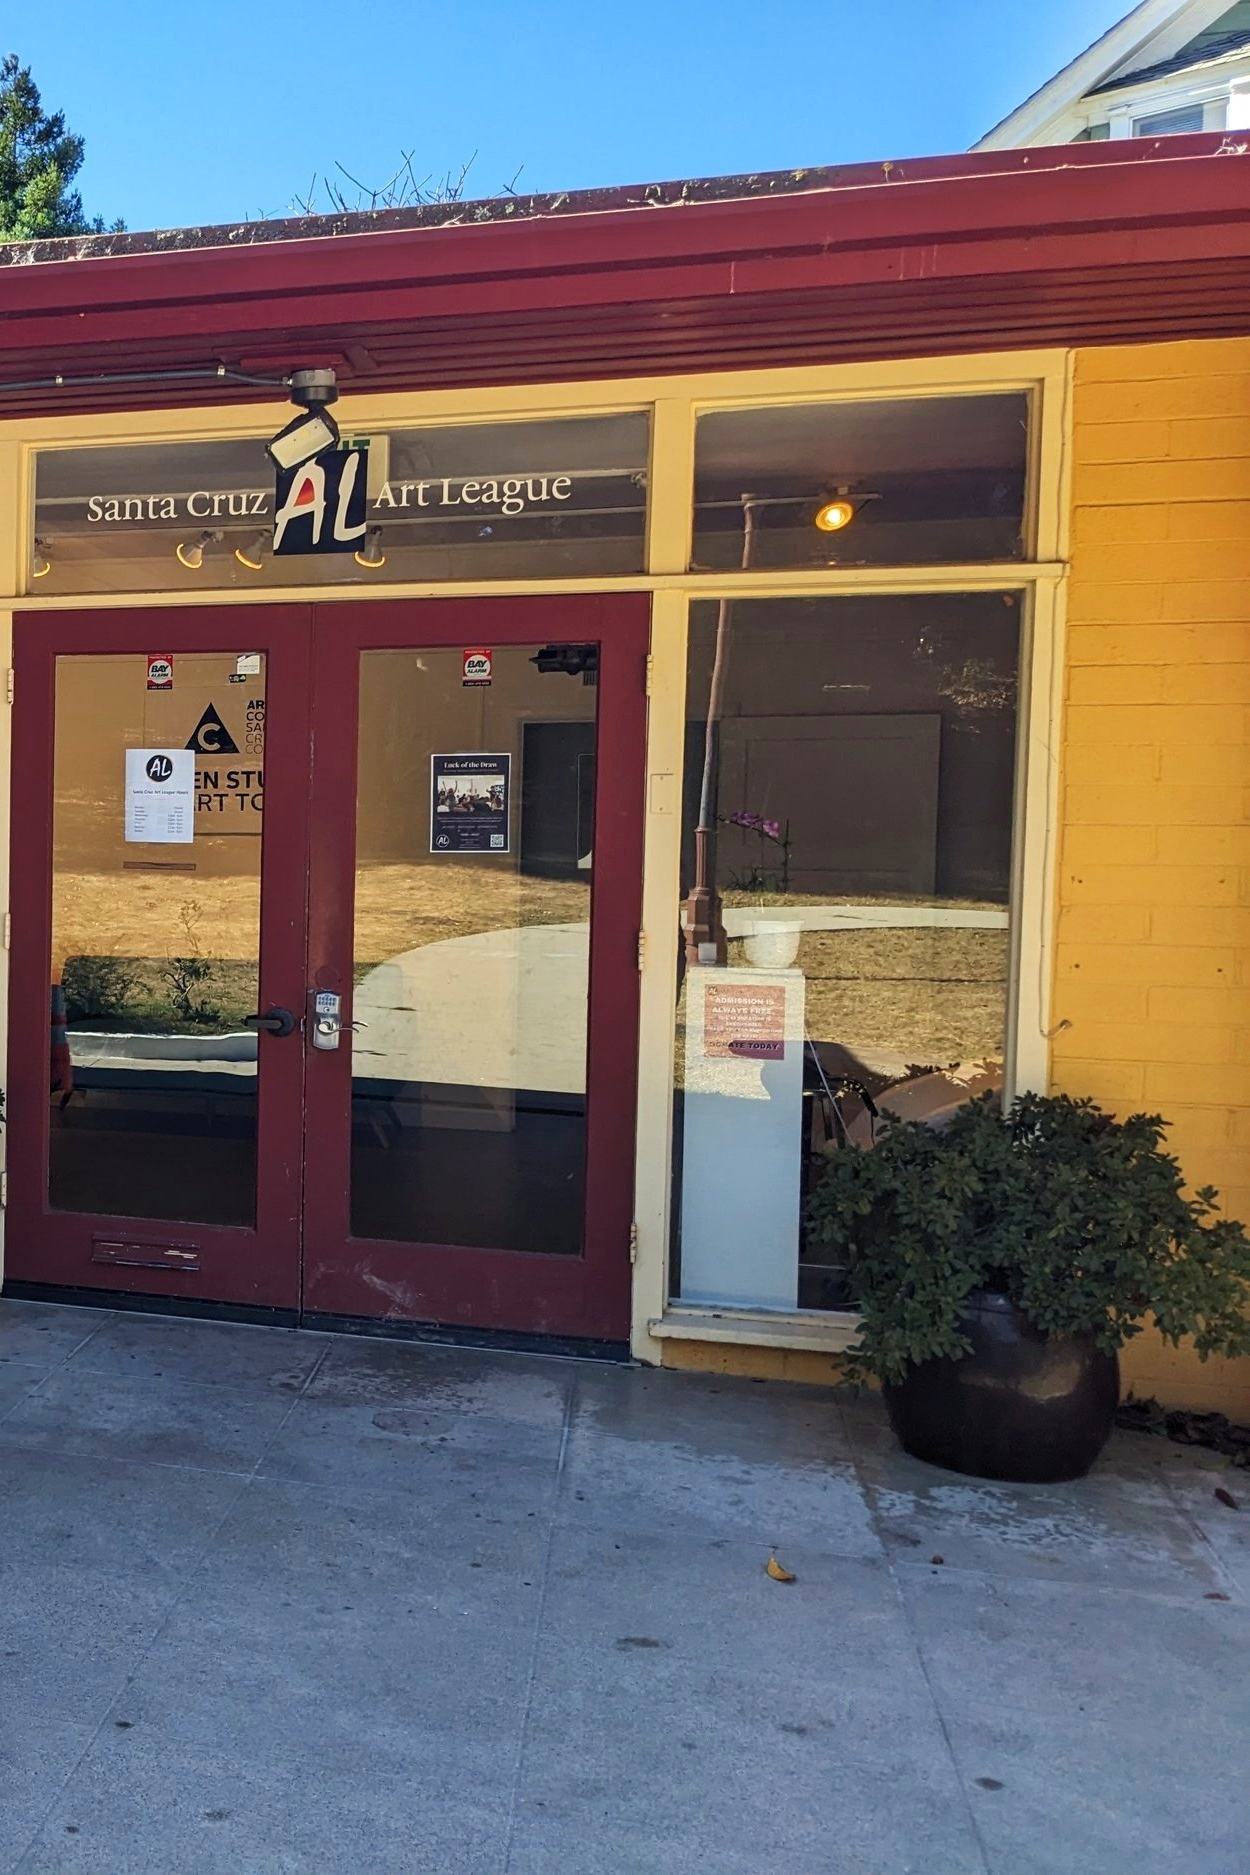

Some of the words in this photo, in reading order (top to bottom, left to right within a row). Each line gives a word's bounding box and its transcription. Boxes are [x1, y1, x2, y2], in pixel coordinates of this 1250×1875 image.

[87, 495, 178, 522] Santa
[187, 491, 268, 517] Cruz
[372, 480, 430, 509] Art
[439, 476, 571, 515] League
[151, 665, 169, 673] BAY
[467, 660, 488, 668] BAY
[247, 700, 265, 710] AR
[246, 711, 265, 721] CO
[150, 758, 171, 777] AL
[195, 794, 229, 812] RT
[715, 997, 764, 1005] ADMISSION
[747, 1042, 779, 1050] TODAY
